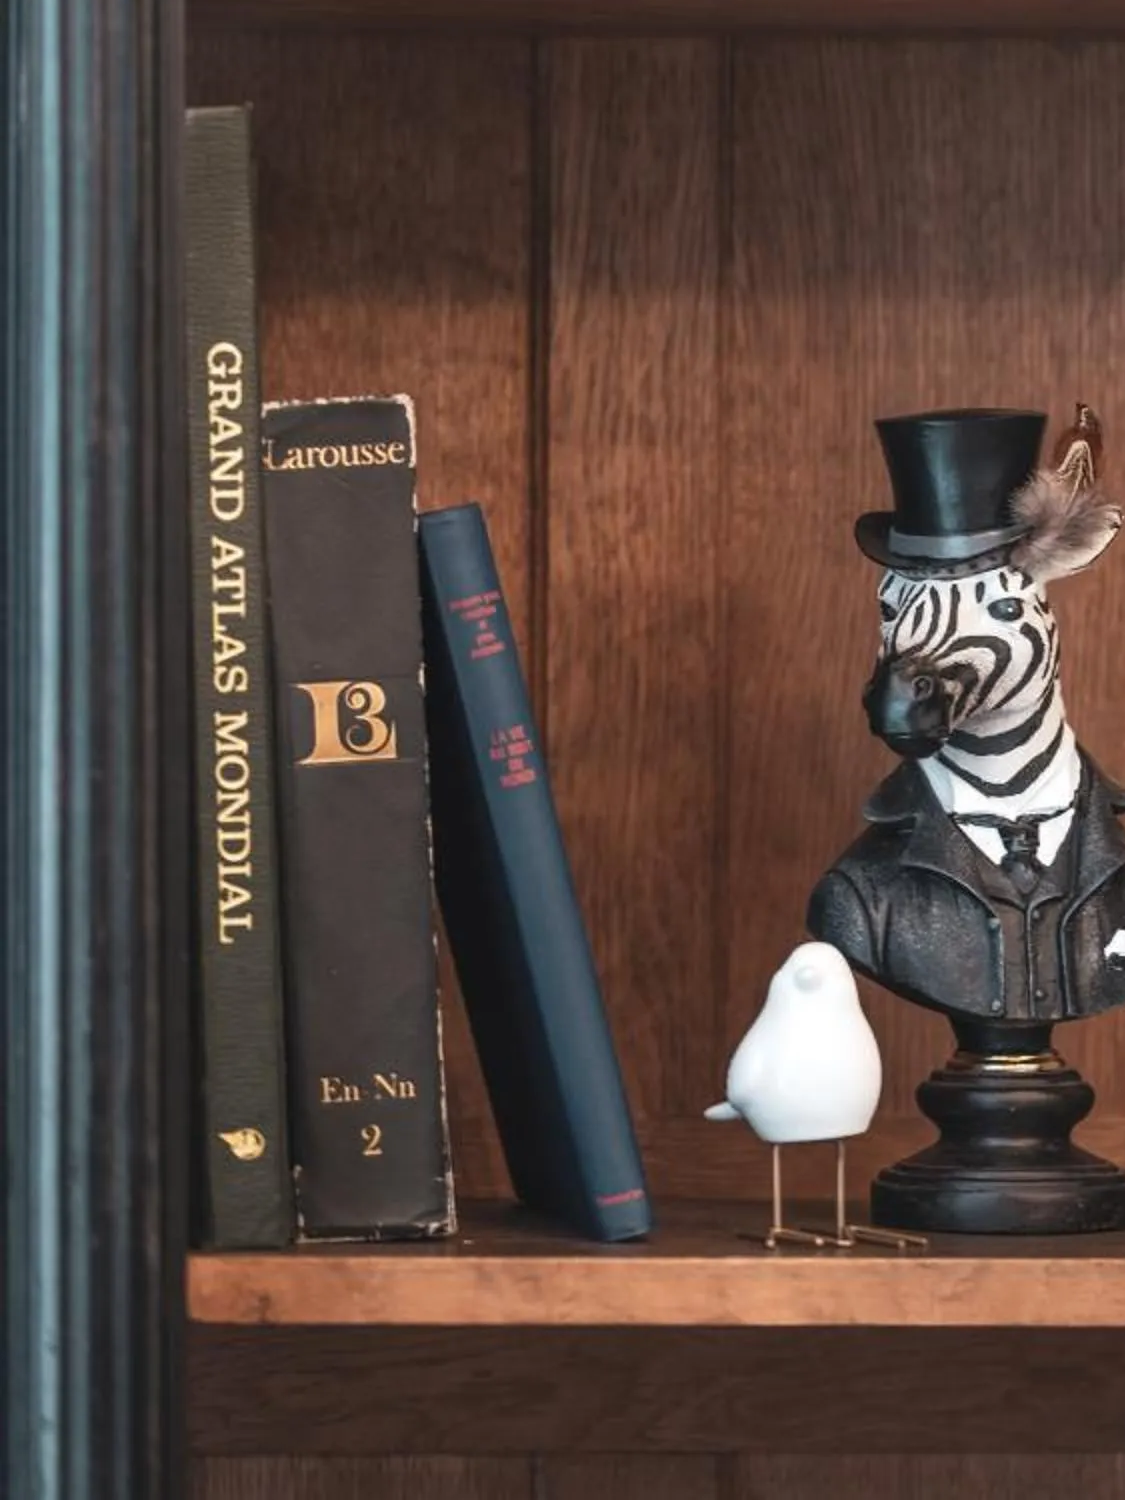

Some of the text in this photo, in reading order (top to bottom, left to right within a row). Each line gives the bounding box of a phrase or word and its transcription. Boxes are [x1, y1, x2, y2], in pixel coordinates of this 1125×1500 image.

[262, 438, 405, 470] Larousse
[207, 342, 253, 945] GRAND ATLAS MONDIAL
[361, 1123, 383, 1156] 2
